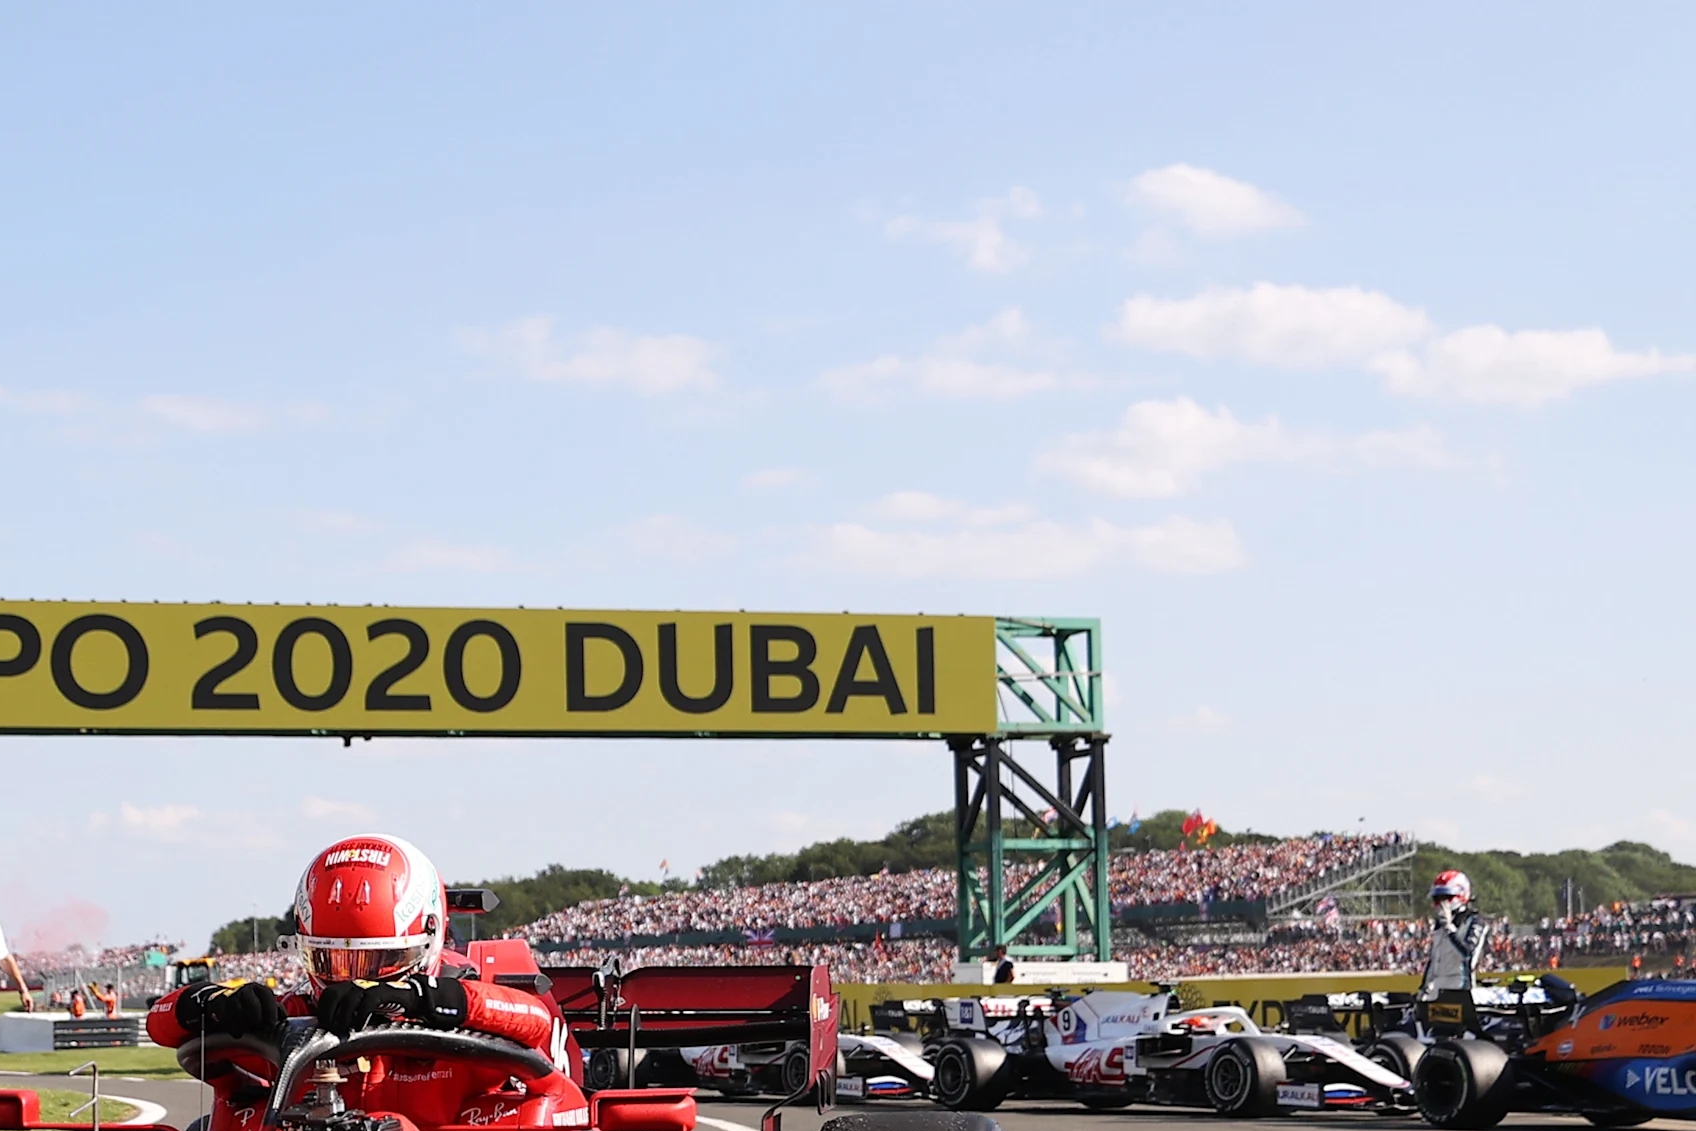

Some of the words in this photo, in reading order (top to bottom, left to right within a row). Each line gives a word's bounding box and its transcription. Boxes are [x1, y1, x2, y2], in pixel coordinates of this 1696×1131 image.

[191, 614, 522, 713] 2020
[566, 622, 936, 715] DUBAI
[1062, 1010, 1071, 1032] 9
